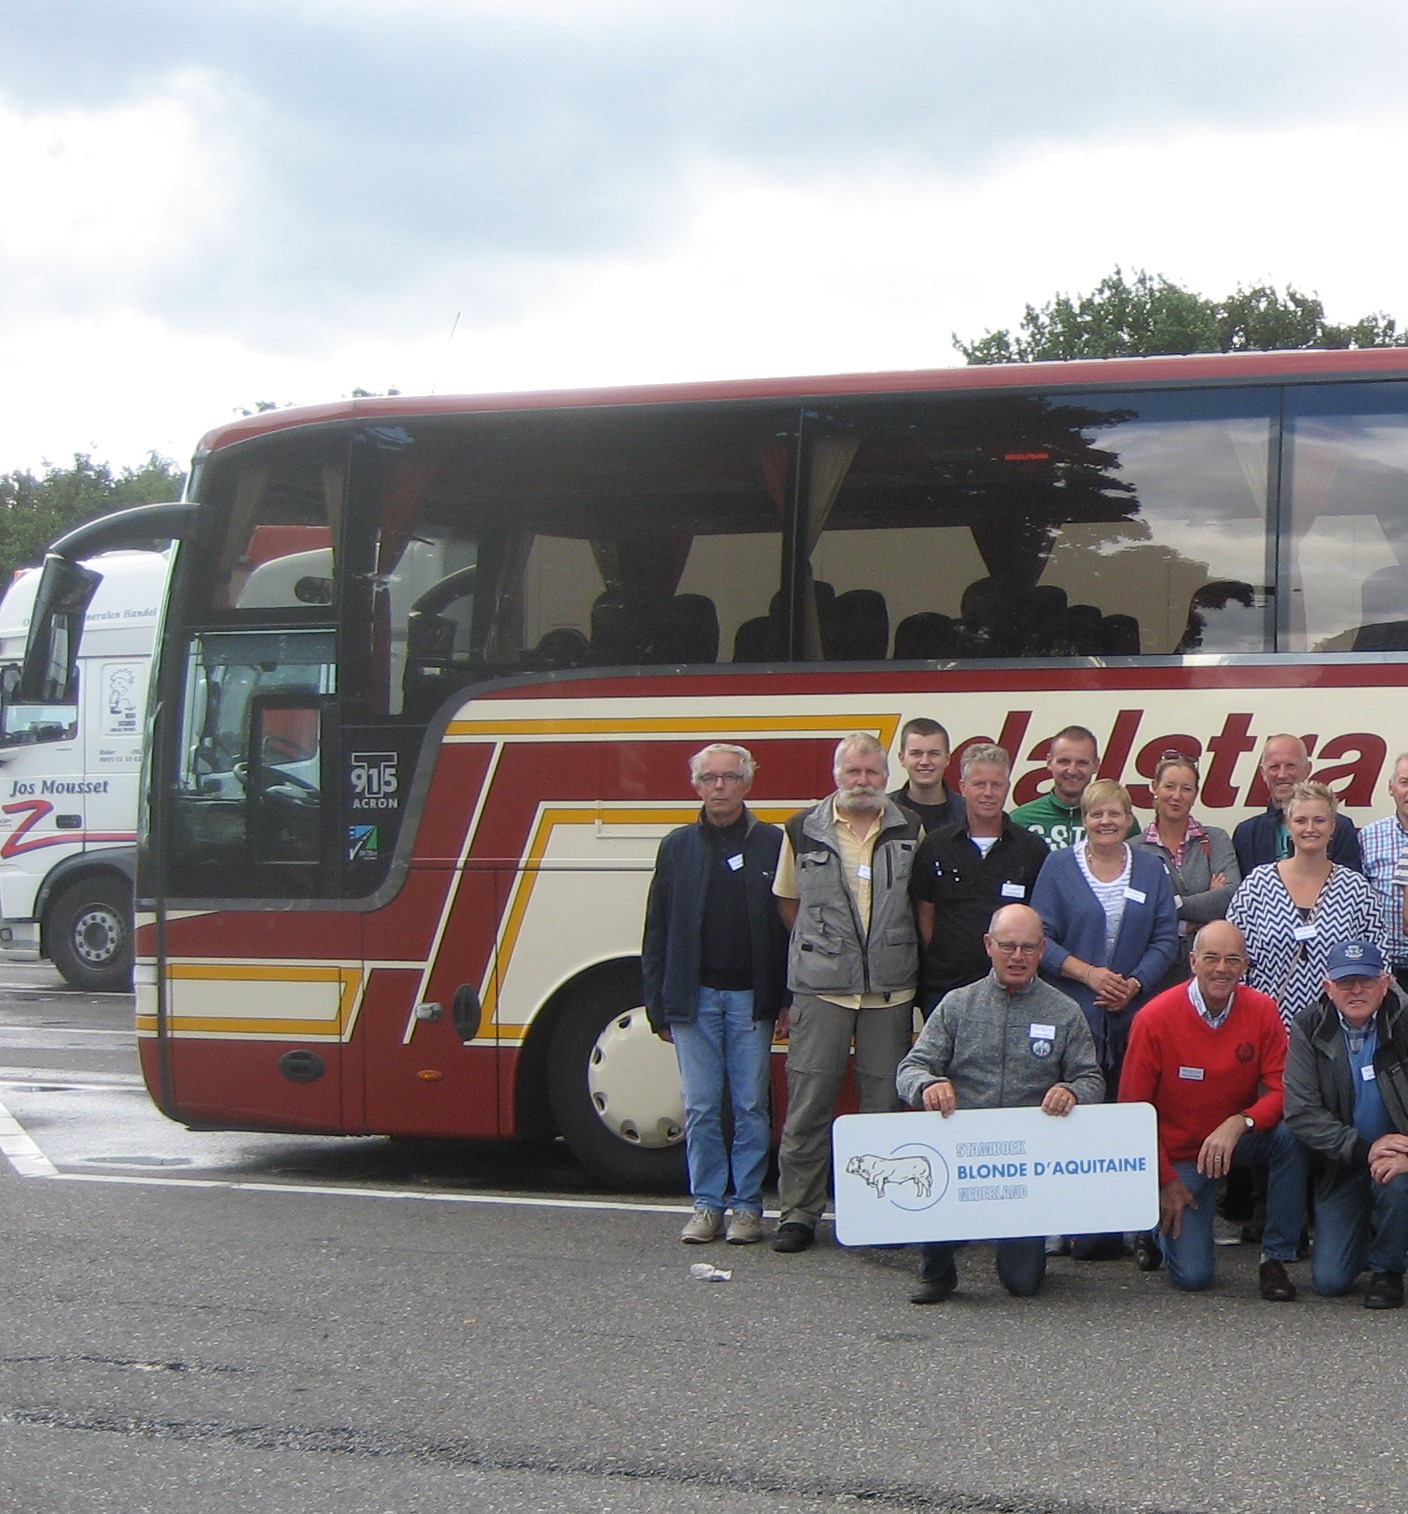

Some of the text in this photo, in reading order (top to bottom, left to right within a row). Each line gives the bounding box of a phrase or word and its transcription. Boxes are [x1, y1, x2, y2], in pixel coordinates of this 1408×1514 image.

[9, 779, 110, 797] Jos Mousset
[353, 799, 398, 808] ACRON
[955, 1140, 1027, 1158] STAMBOEK
[956, 1156, 1147, 1180] BLONDE D'AQUITAINE
[957, 1184, 1028, 1202] NEDERLAND
